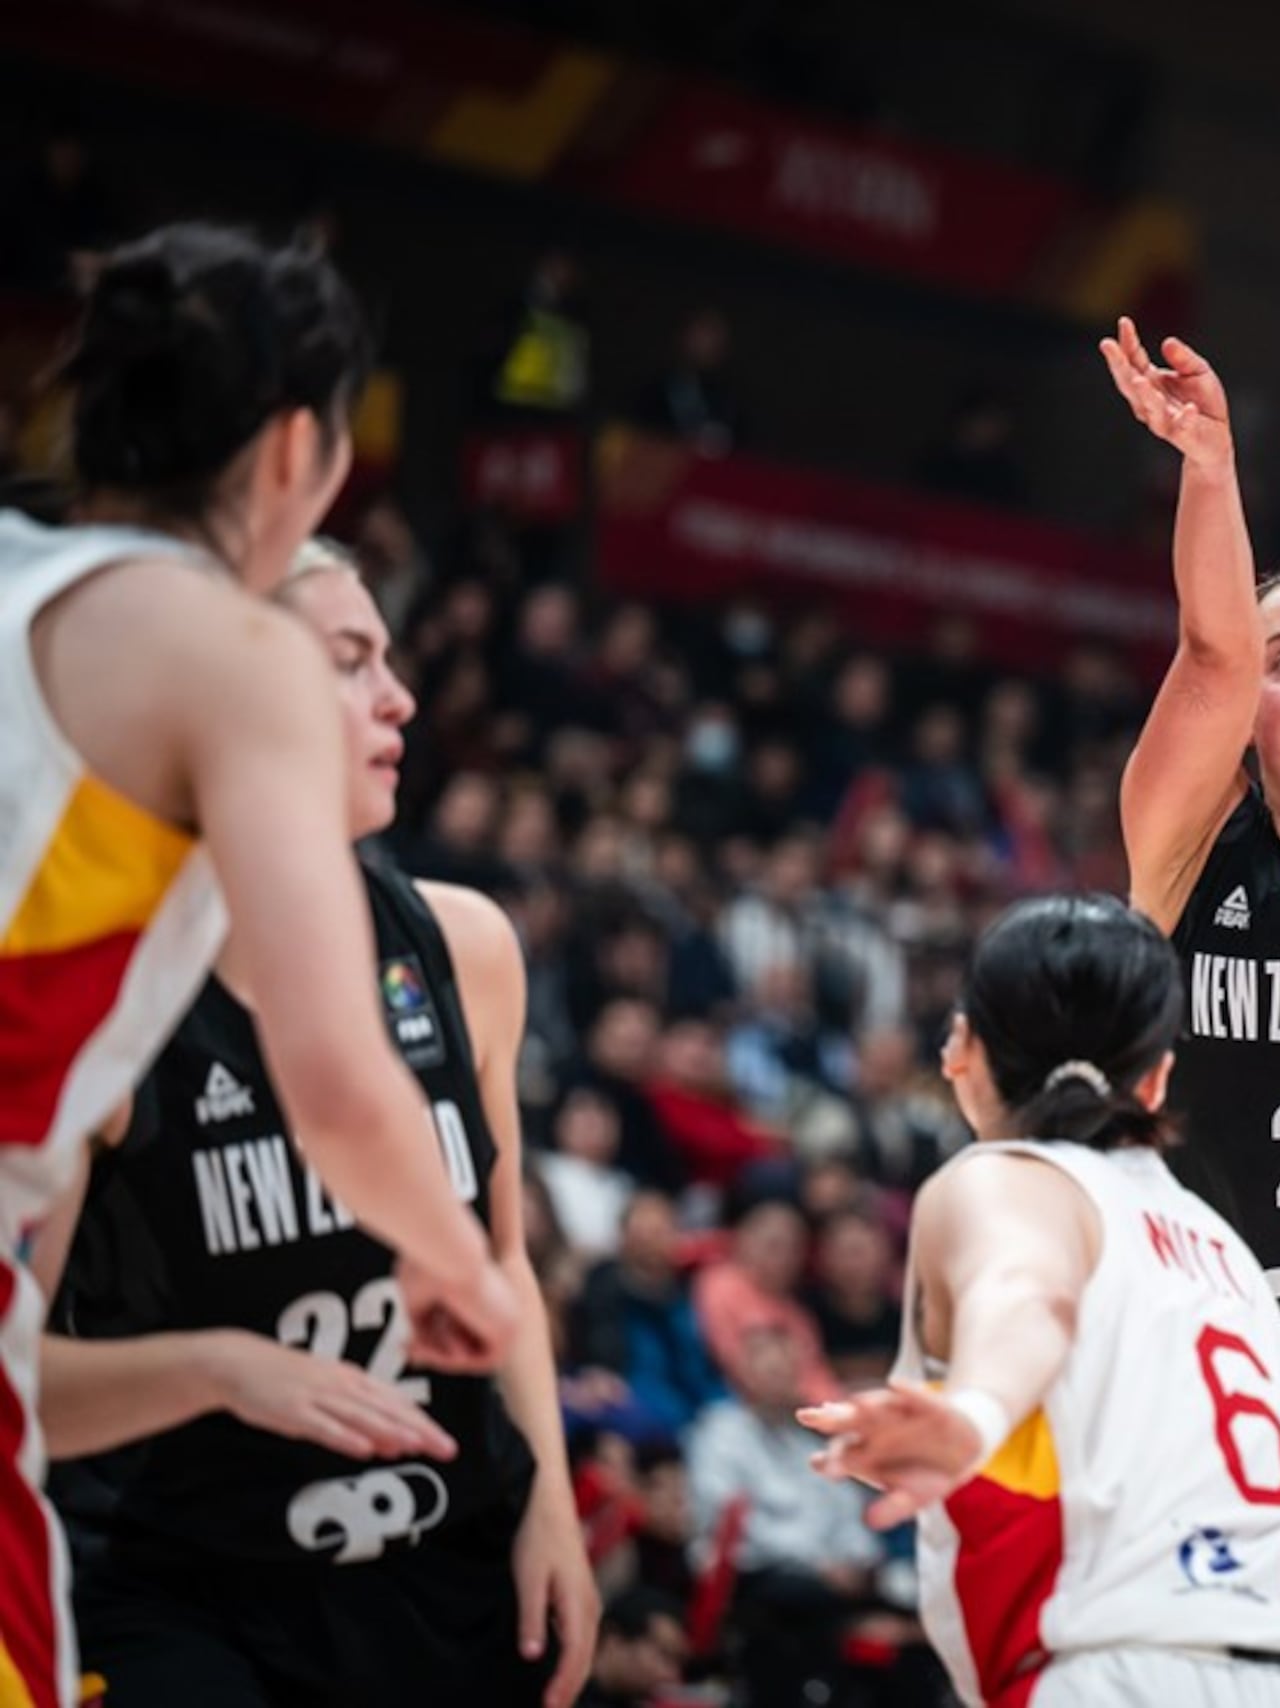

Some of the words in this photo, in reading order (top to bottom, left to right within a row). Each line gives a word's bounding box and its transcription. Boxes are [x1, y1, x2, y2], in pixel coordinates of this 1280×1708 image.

[1192, 952, 1258, 1041] NEW
[192, 1134, 300, 1256] NEW
[276, 1275, 432, 1404] 22
